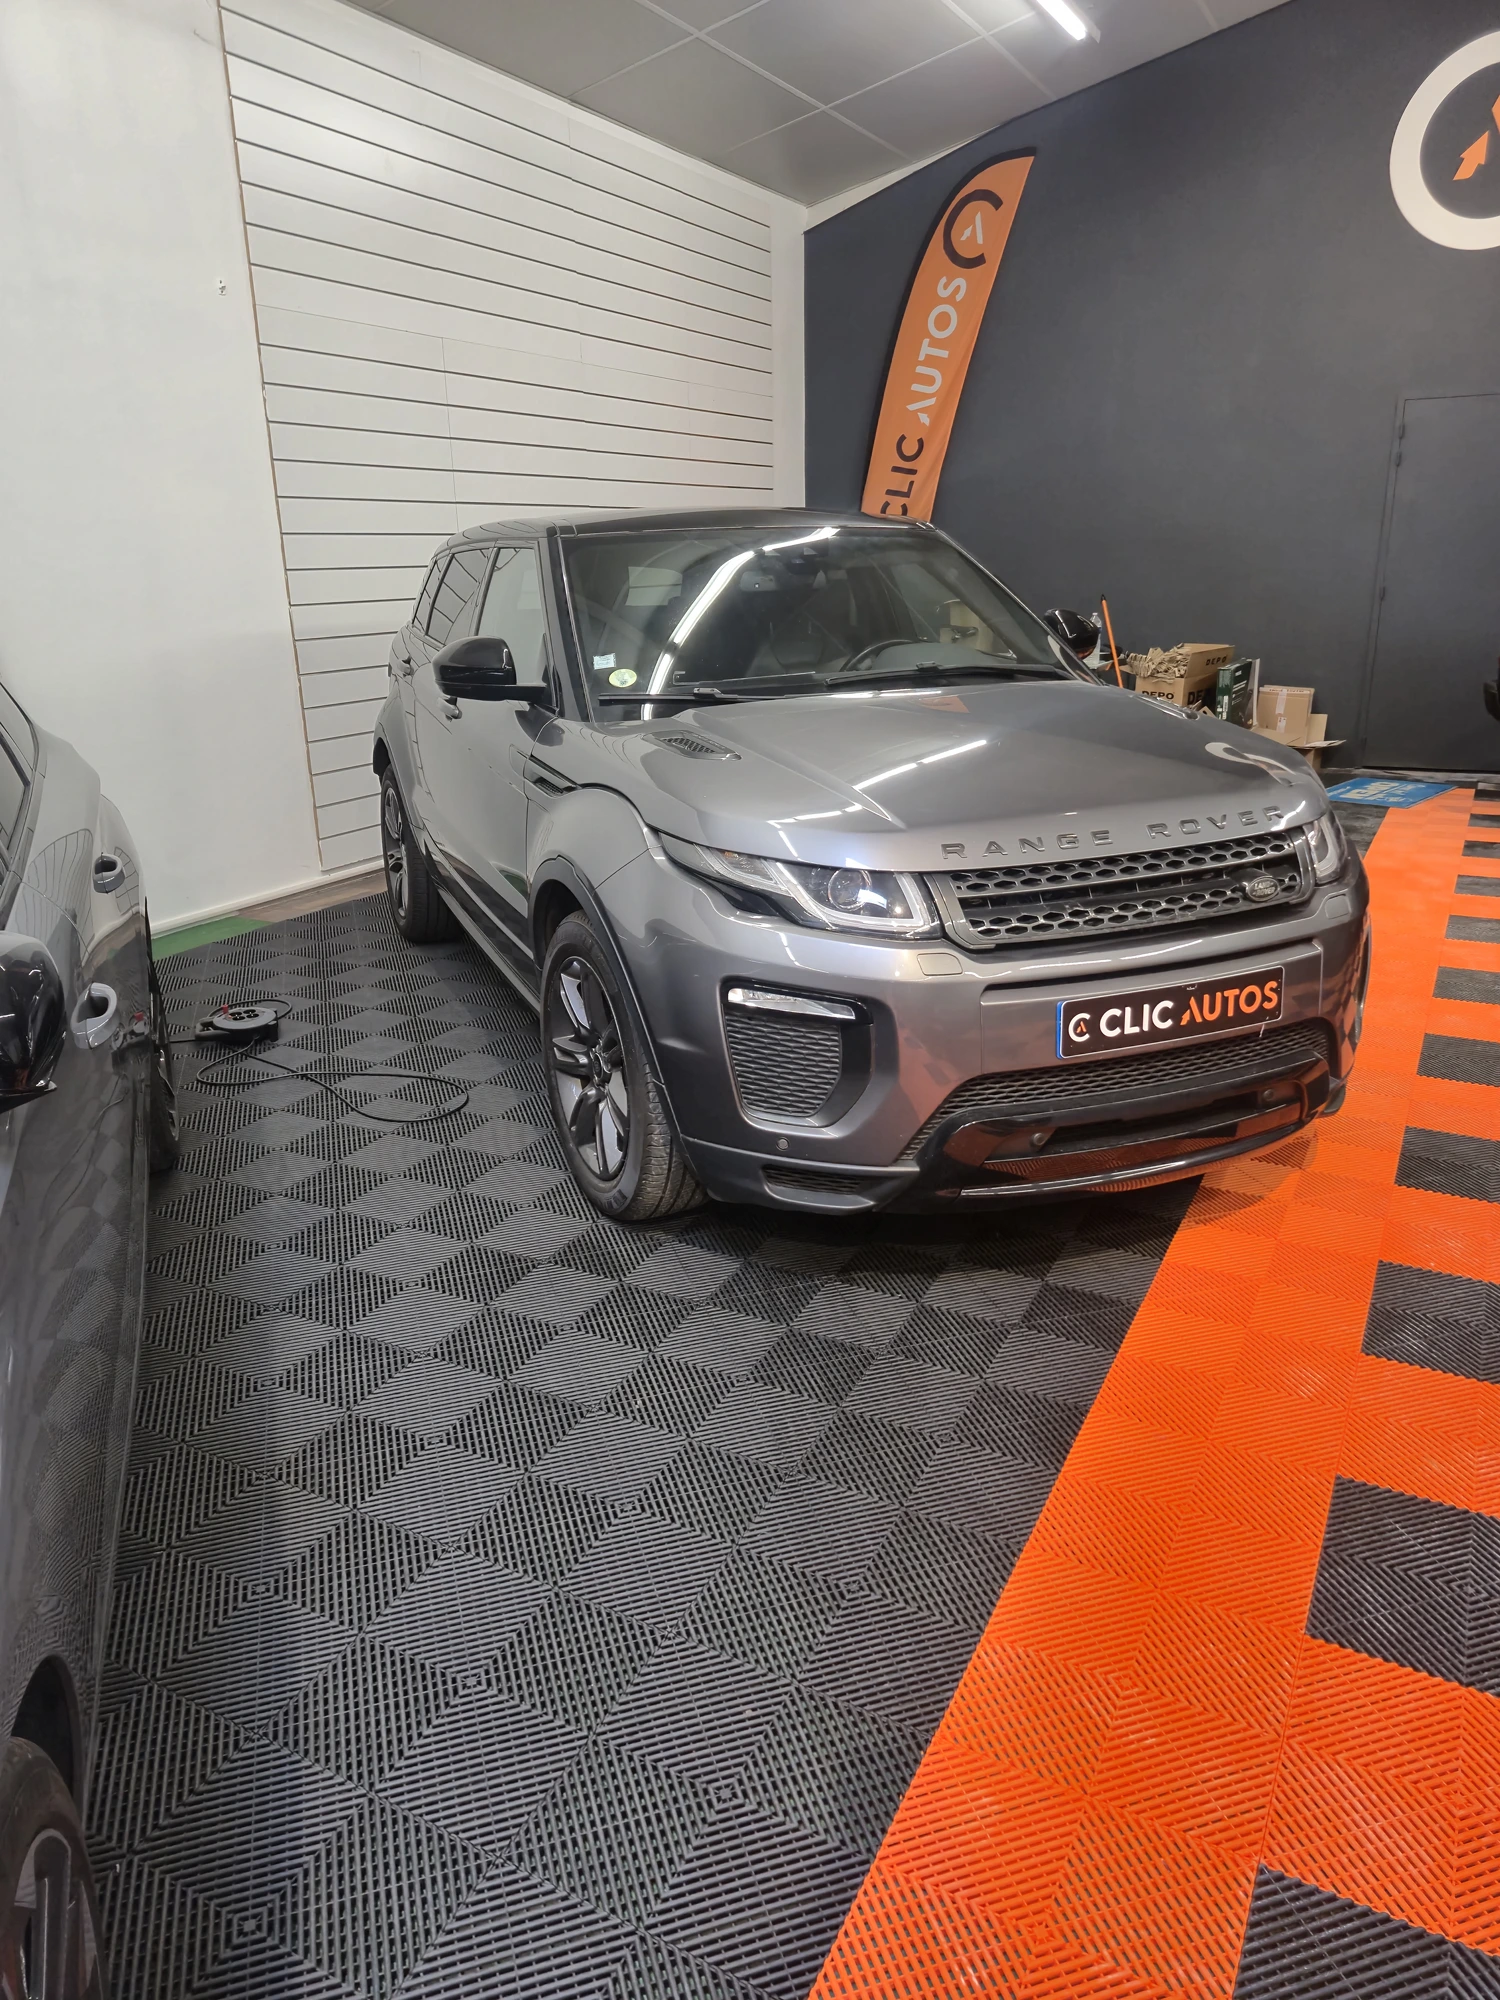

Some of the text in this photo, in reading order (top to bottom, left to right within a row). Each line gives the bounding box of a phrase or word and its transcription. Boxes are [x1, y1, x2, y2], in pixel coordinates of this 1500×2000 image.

[880, 276, 967, 517] CLIC AUTOS
[1205, 656, 1227, 666] DEPO
[941, 805, 1285, 859] RANGE ROVER
[1099, 1000, 1174, 1038] CLIC
[1180, 980, 1279, 1026] AUTOS
